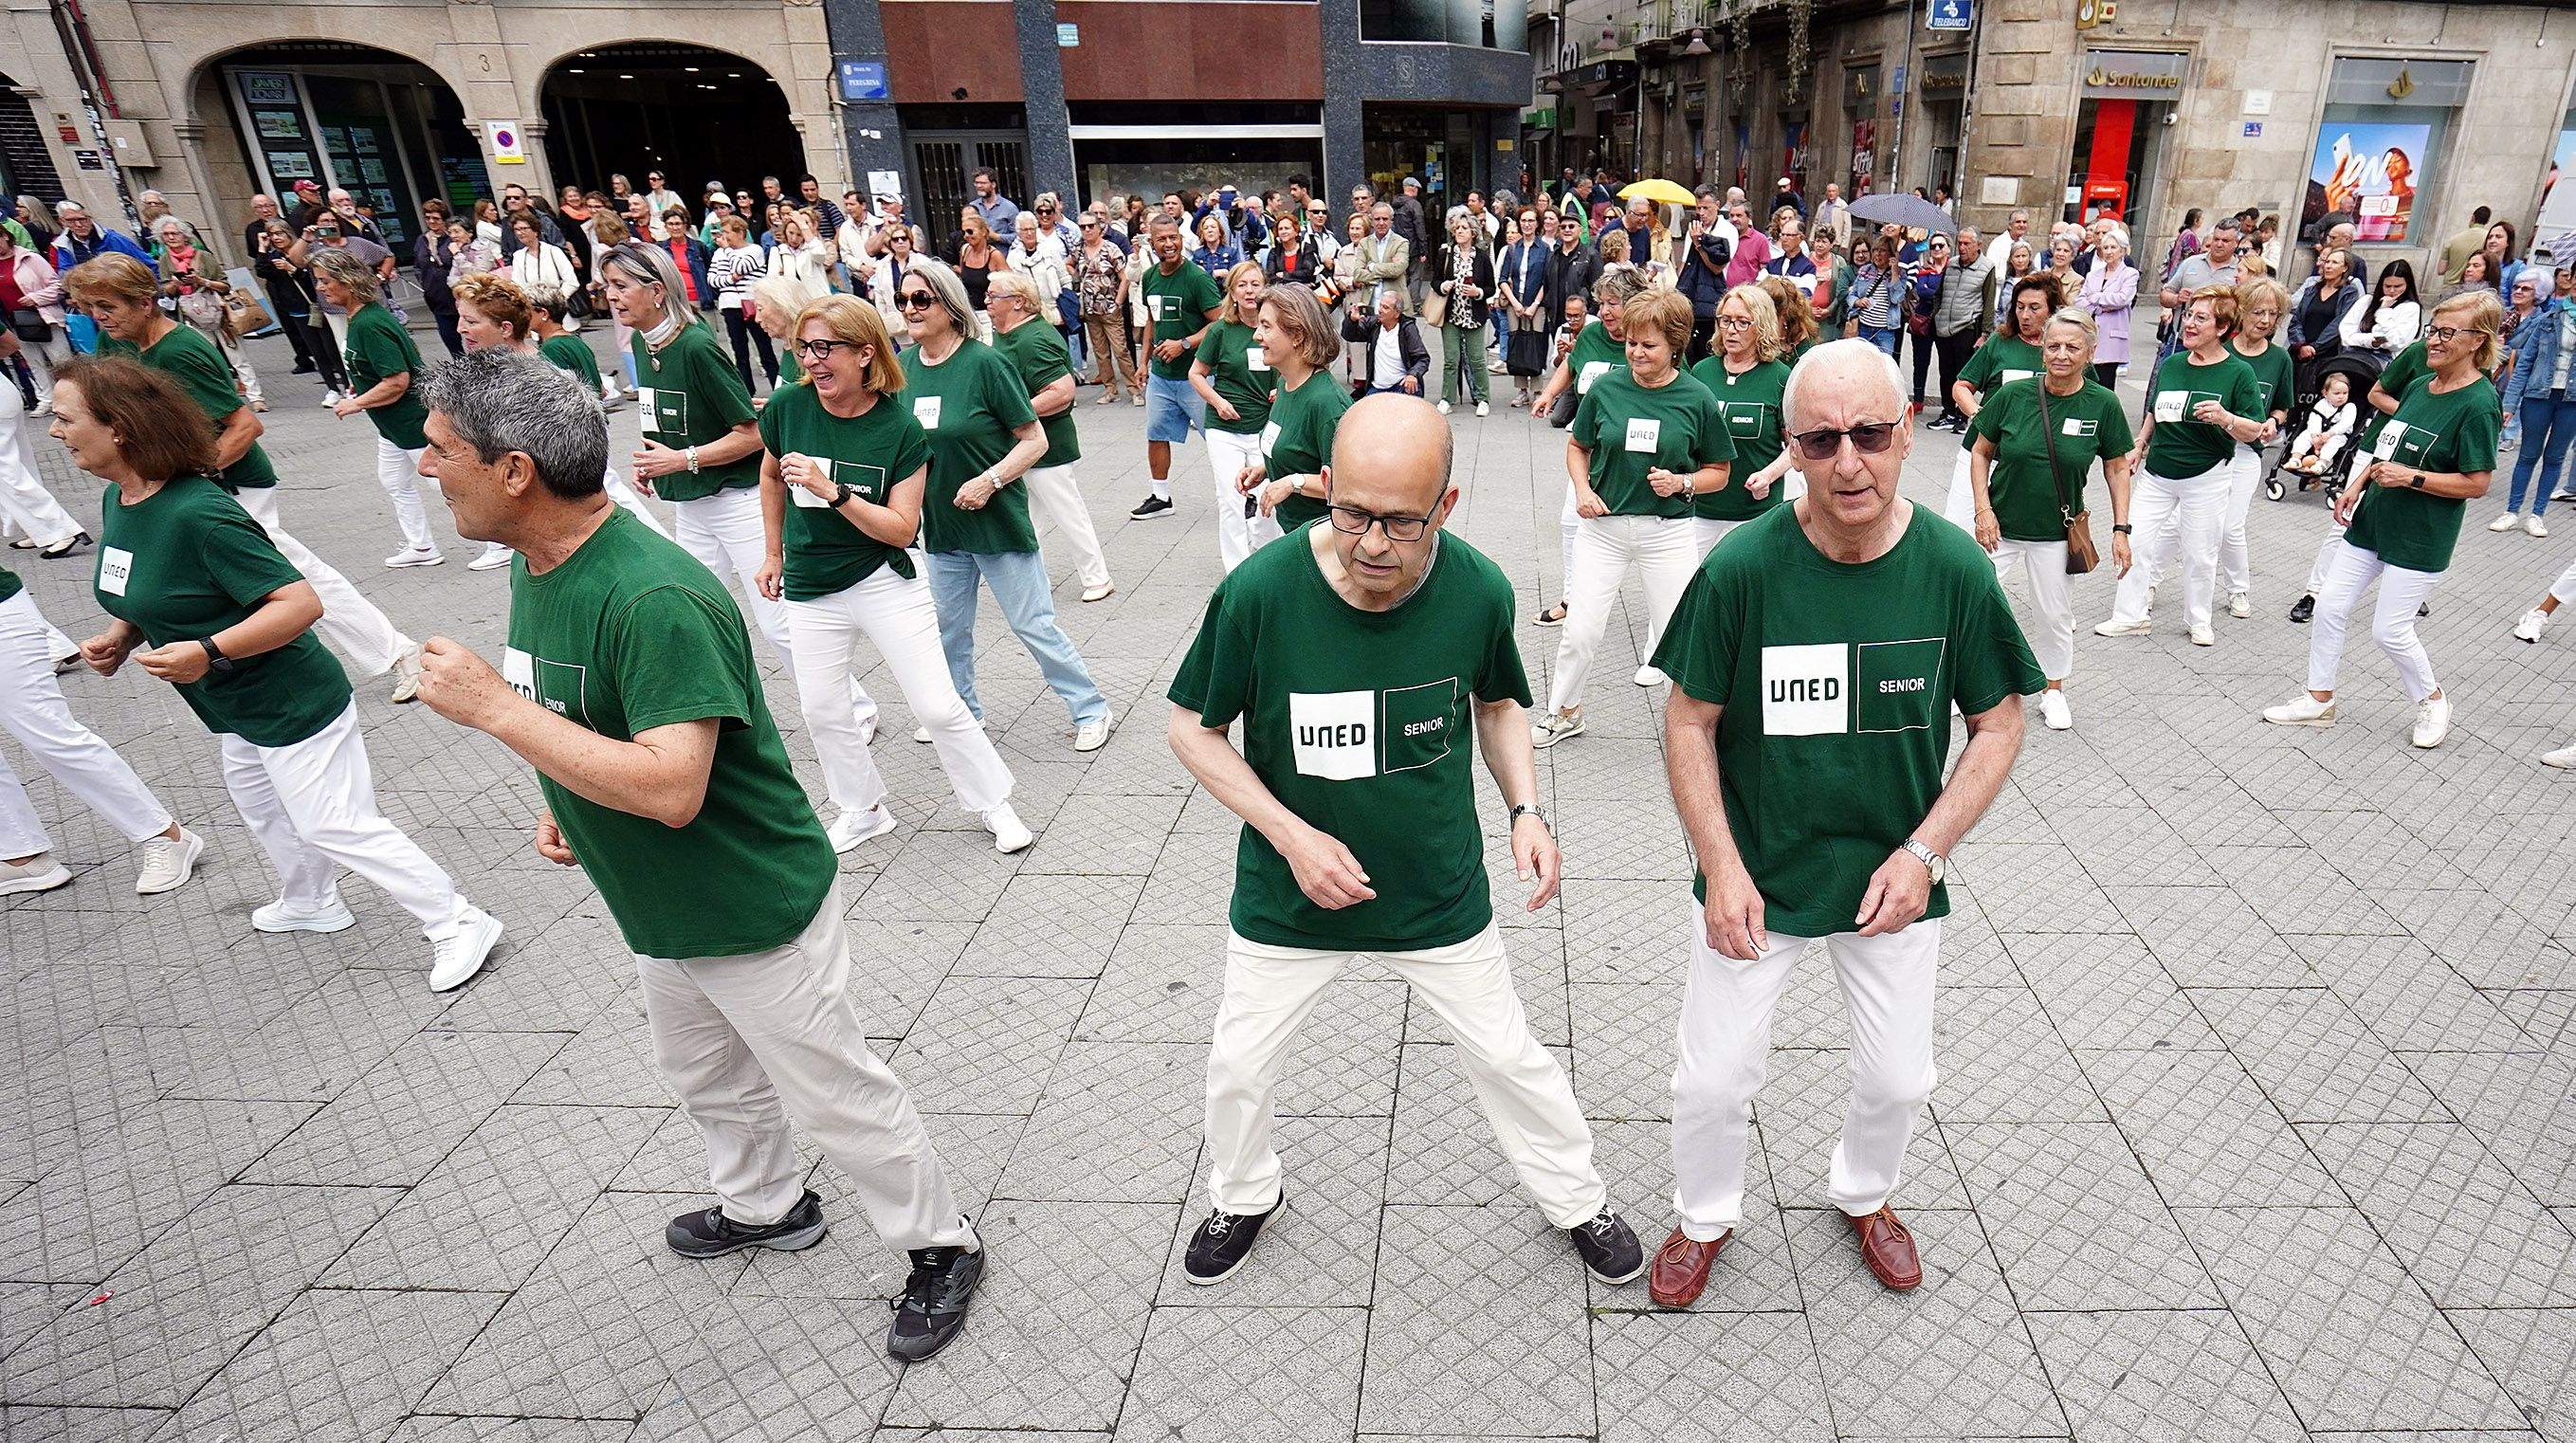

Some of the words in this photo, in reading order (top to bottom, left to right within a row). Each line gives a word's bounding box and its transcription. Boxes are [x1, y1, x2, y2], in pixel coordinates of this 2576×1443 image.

[1934, 18, 1967, 27] TELEBANCO
[478, 53, 490, 72] 3
[2107, 70, 2180, 87] Santander
[1630, 429, 1655, 441] UNED
[104, 562, 127, 579] UNED
[1771, 677, 1840, 703] UNED
[1878, 677, 1927, 694] SENIOR
[1300, 722, 1367, 749] UNED
[1403, 716, 1445, 738] SENIOR
